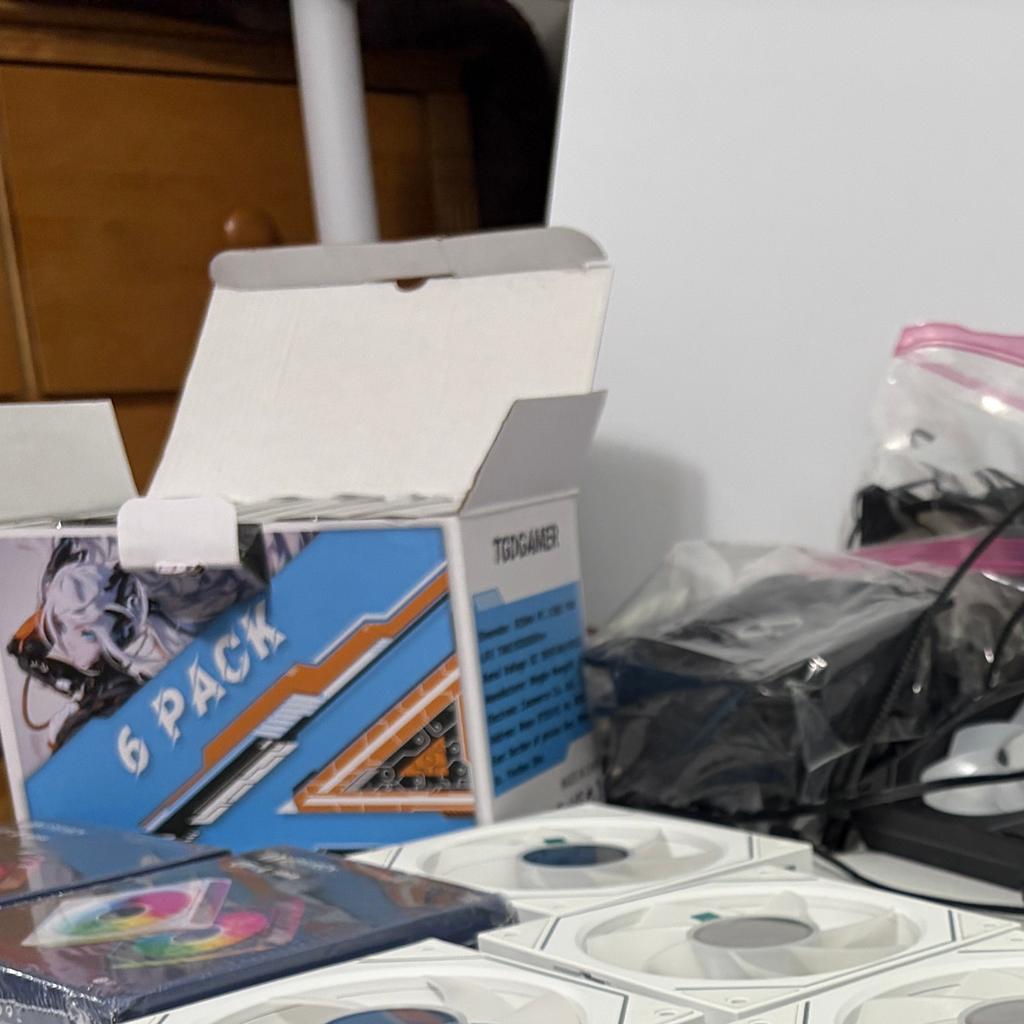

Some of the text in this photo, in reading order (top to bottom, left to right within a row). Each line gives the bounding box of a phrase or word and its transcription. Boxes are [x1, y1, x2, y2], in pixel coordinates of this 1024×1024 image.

[492, 522, 560, 565] TGDGAMER
[117, 598, 288, 776] 6 PACK
